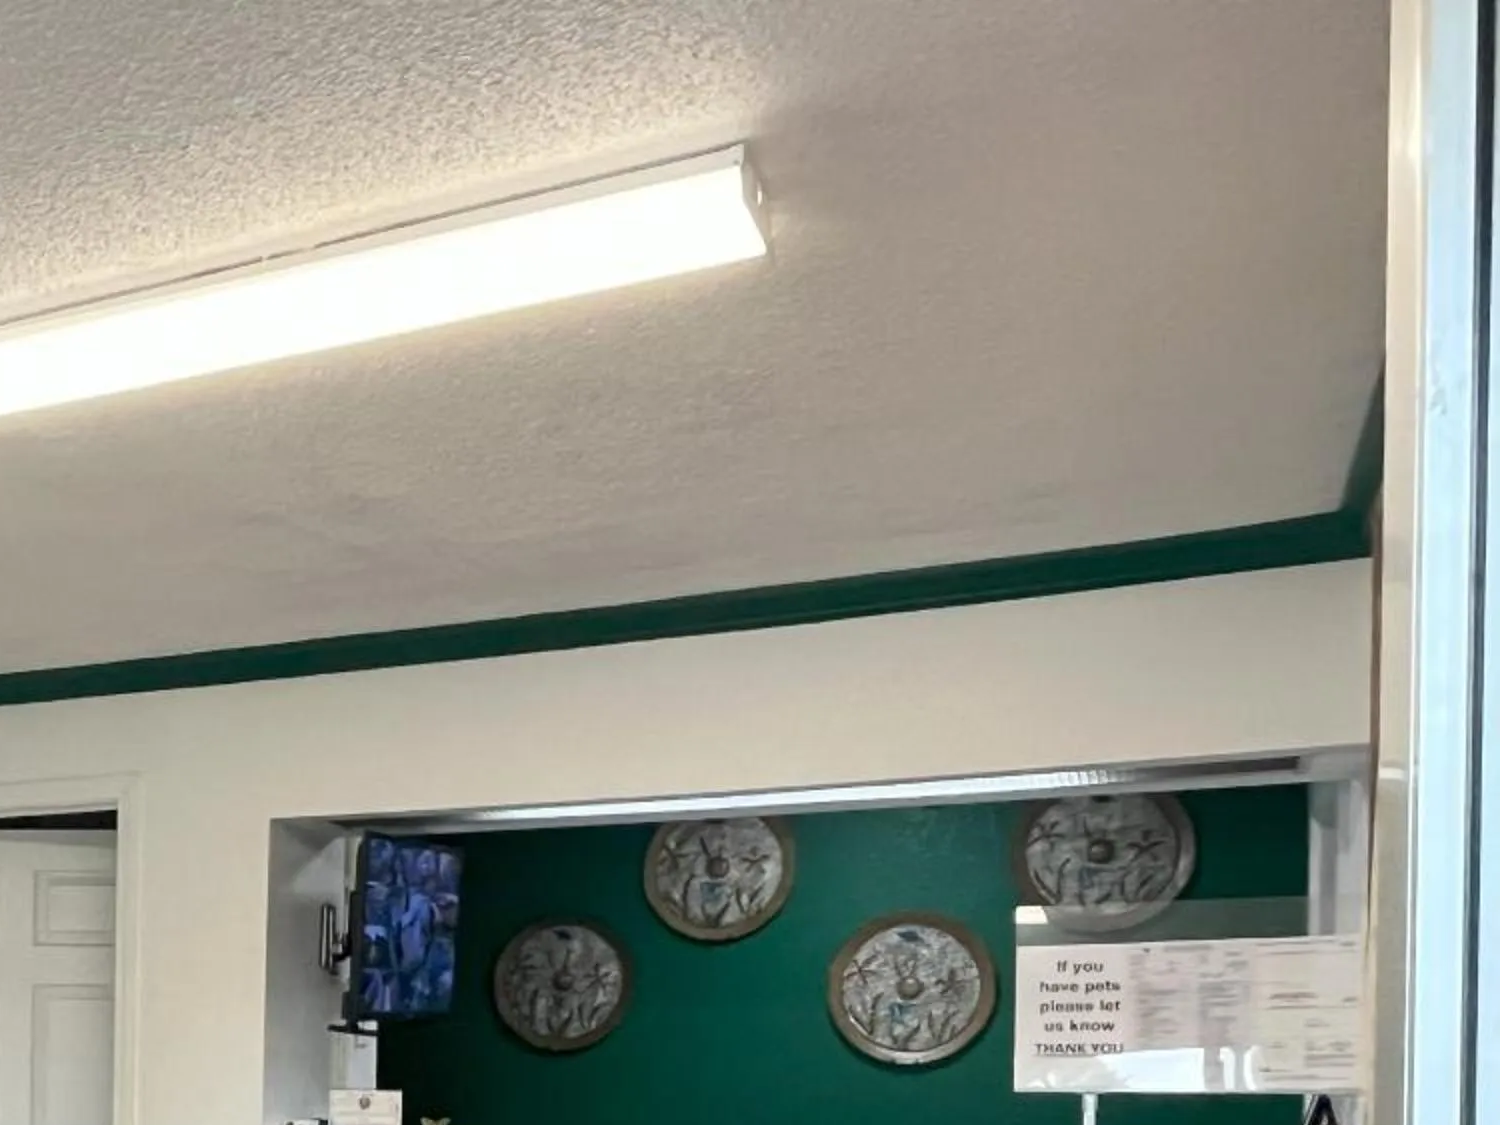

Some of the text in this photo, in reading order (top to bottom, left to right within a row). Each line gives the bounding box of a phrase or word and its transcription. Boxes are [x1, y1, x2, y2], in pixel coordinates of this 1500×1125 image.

[1057, 960, 1104, 975] If you
[1040, 981, 1121, 995] have pets
[1040, 1000, 1121, 1015] please let
[1044, 1020, 1115, 1032] us know
[1035, 1043, 1125, 1054] THANK YOU
